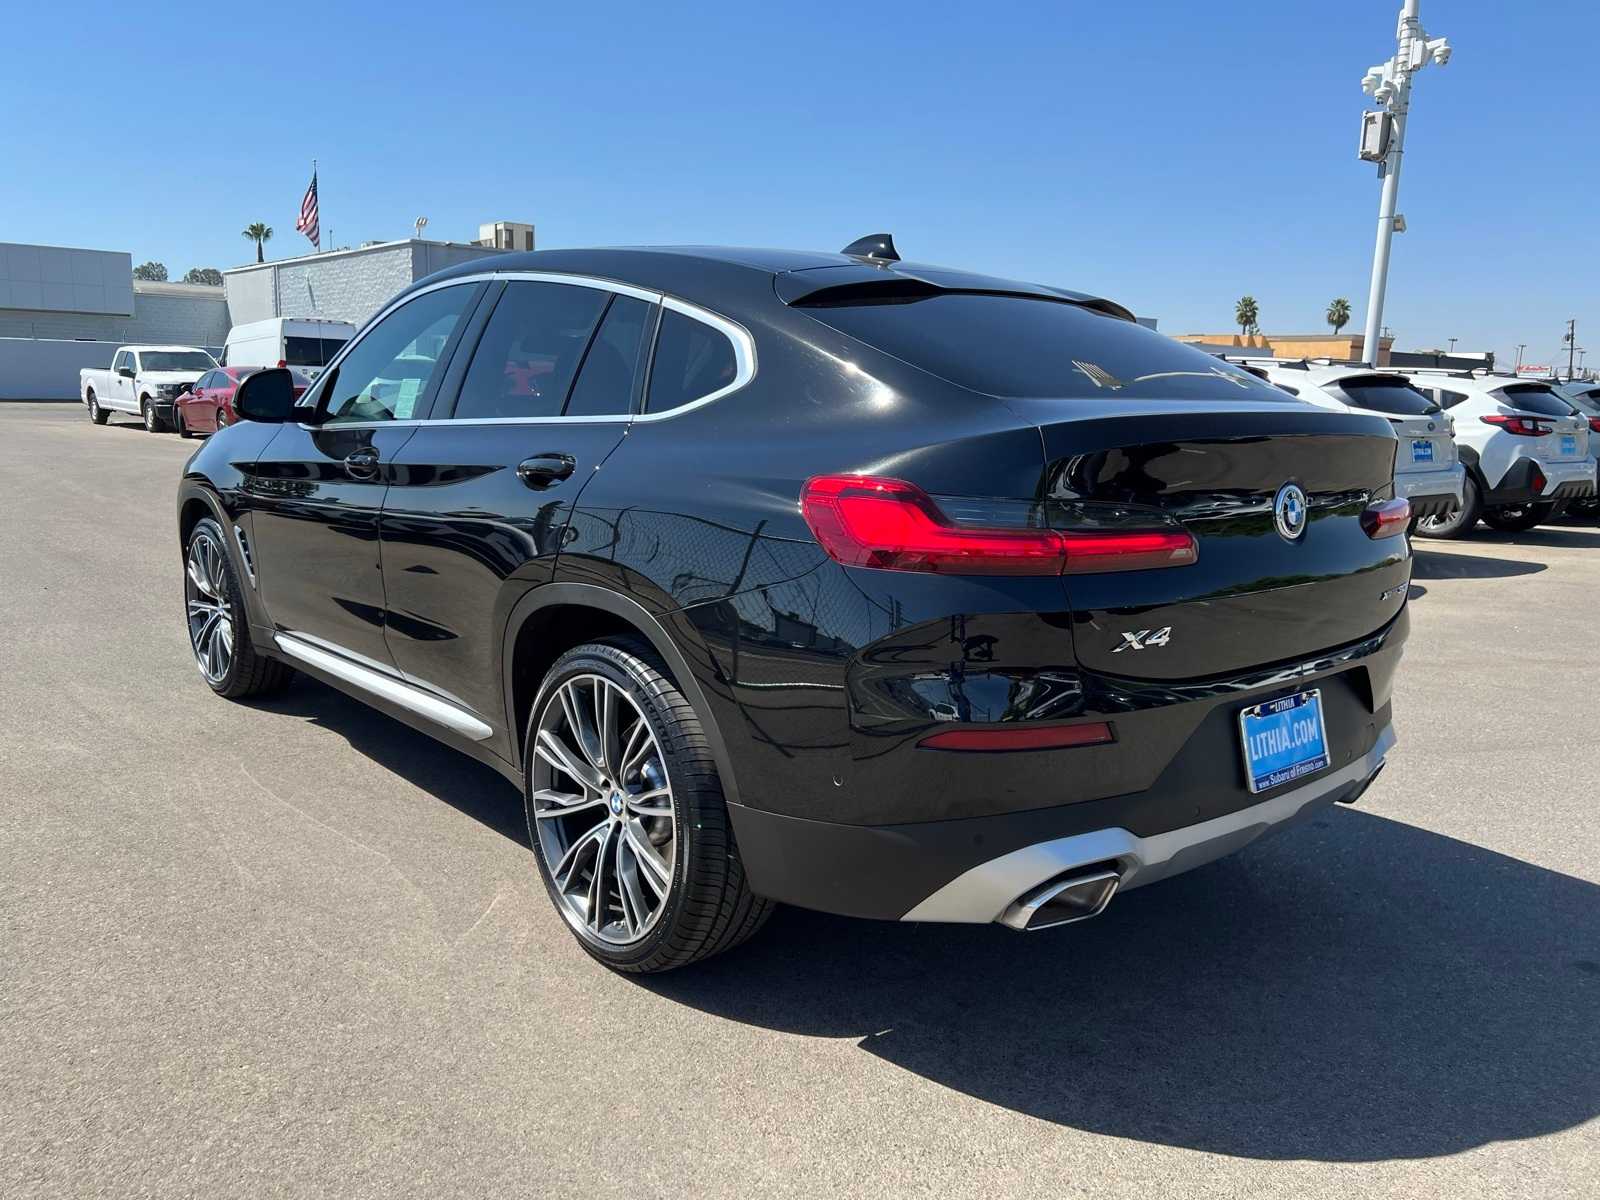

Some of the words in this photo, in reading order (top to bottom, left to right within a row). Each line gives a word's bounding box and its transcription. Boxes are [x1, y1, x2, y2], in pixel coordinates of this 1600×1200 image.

[1111, 626, 1172, 653] X4
[1275, 698, 1295, 712] LITHIA
[1249, 717, 1319, 761] LITHIA.COM
